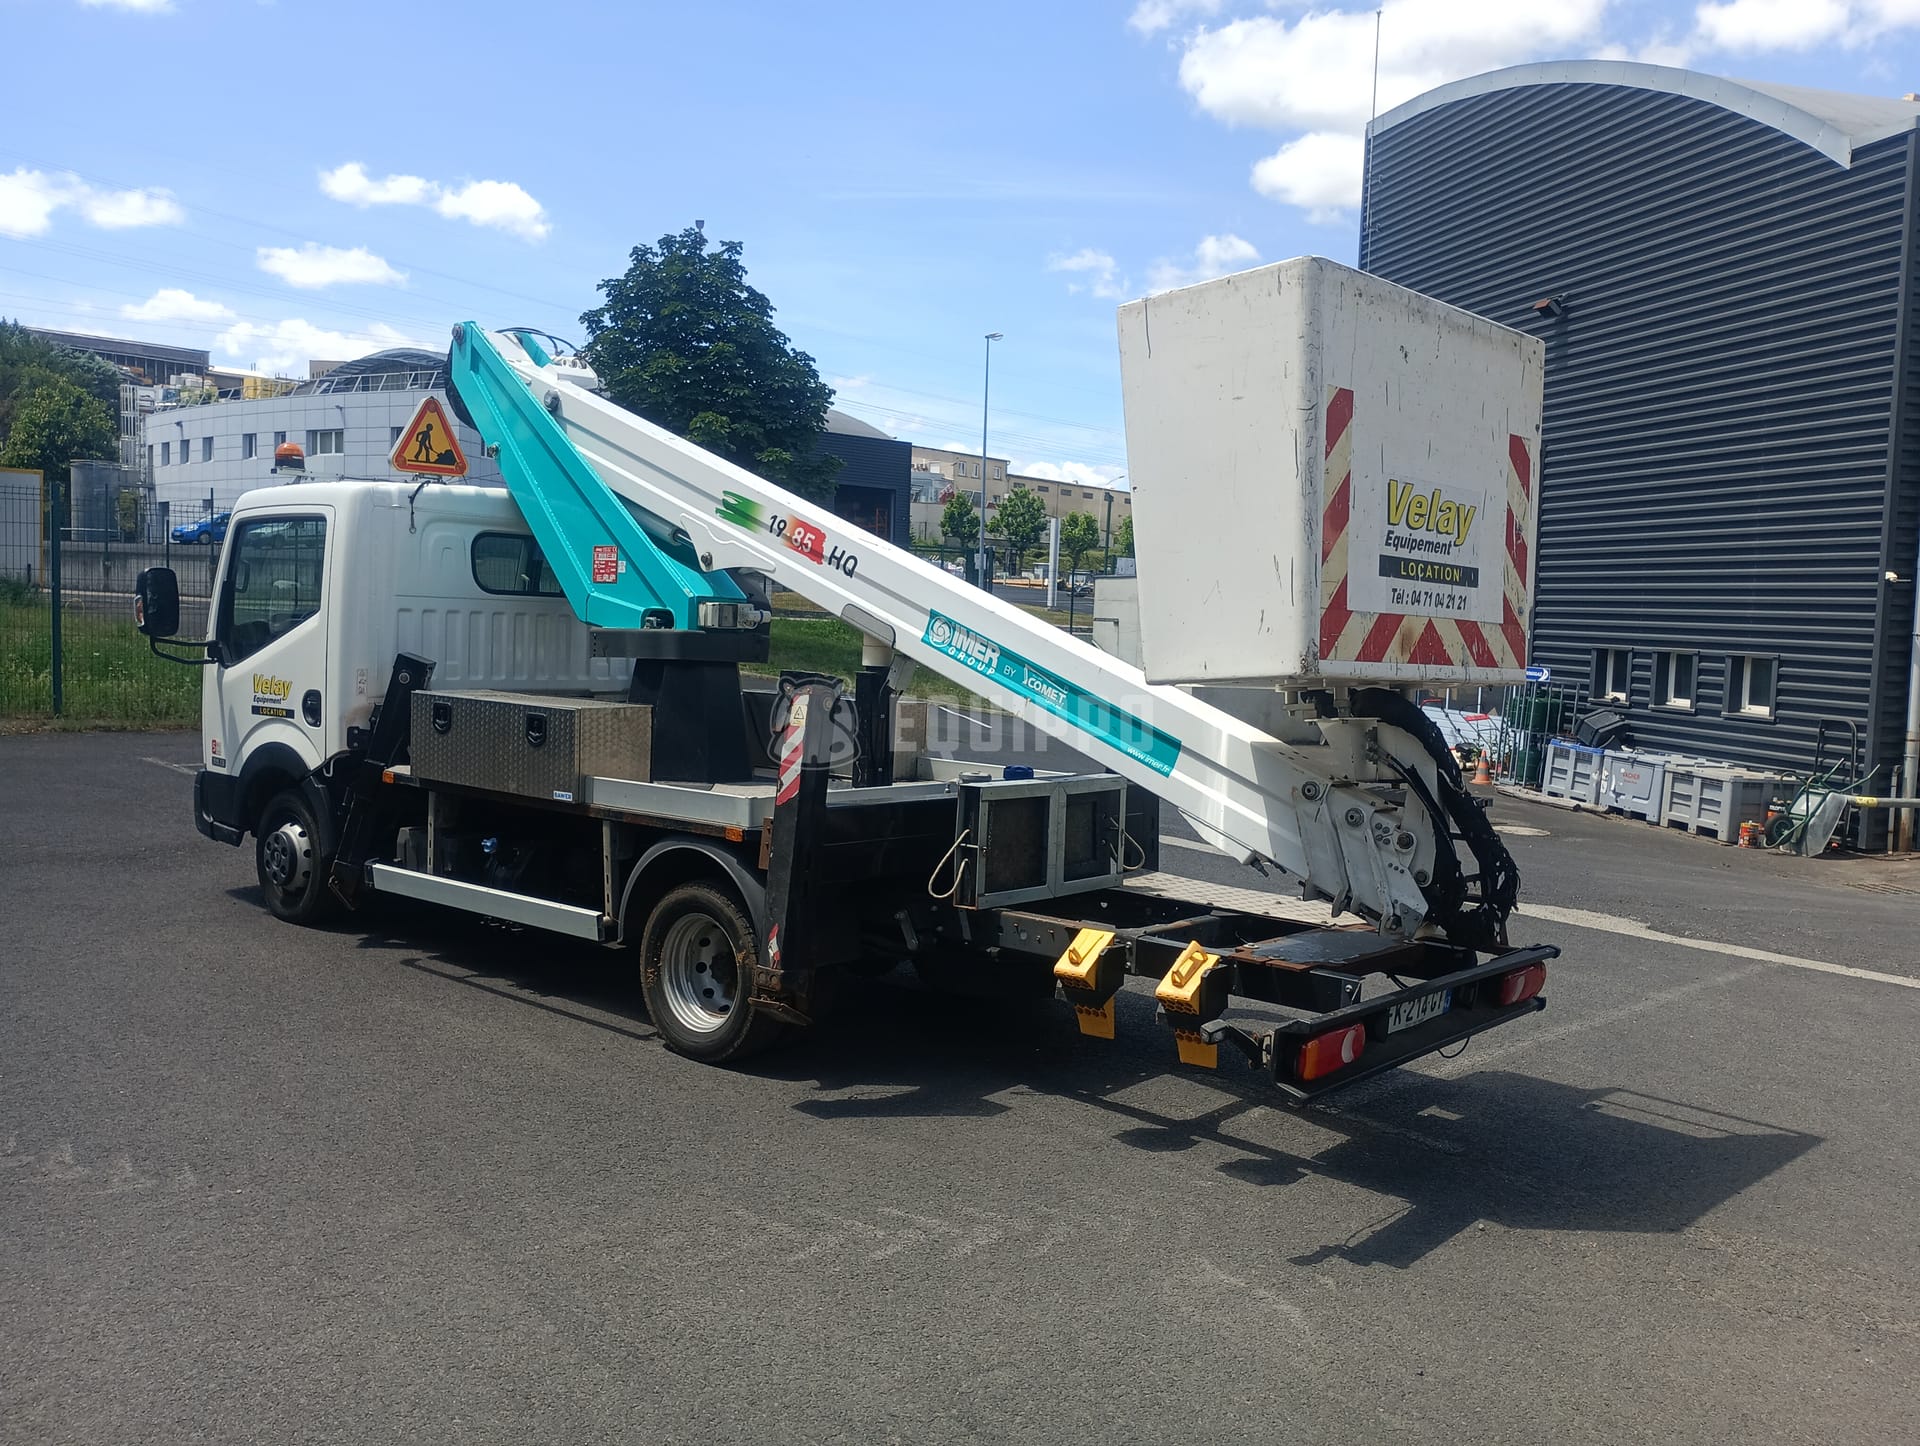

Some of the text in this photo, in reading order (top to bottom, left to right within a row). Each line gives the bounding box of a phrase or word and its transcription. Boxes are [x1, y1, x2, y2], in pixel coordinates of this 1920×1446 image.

[1387, 478, 1477, 547] Velay
[1384, 529, 1452, 556] Equipement
[827, 545, 858, 578] HQ
[1400, 560, 1460, 582] LOCATION
[1411, 590, 1421, 606] 04
[1423, 591, 1433, 607] 71
[1434, 592, 1445, 609] 04
[1445, 594, 1456, 610] 21
[1456, 595, 1467, 611] 21
[947, 646, 996, 676] GROUP
[951, 623, 1001, 669] IMER
[1003, 664, 1017, 677] BY
[252, 672, 293, 701] Velay
[260, 706, 287, 717] LOCATION
[1127, 745, 1170, 773] www.imer.fr
